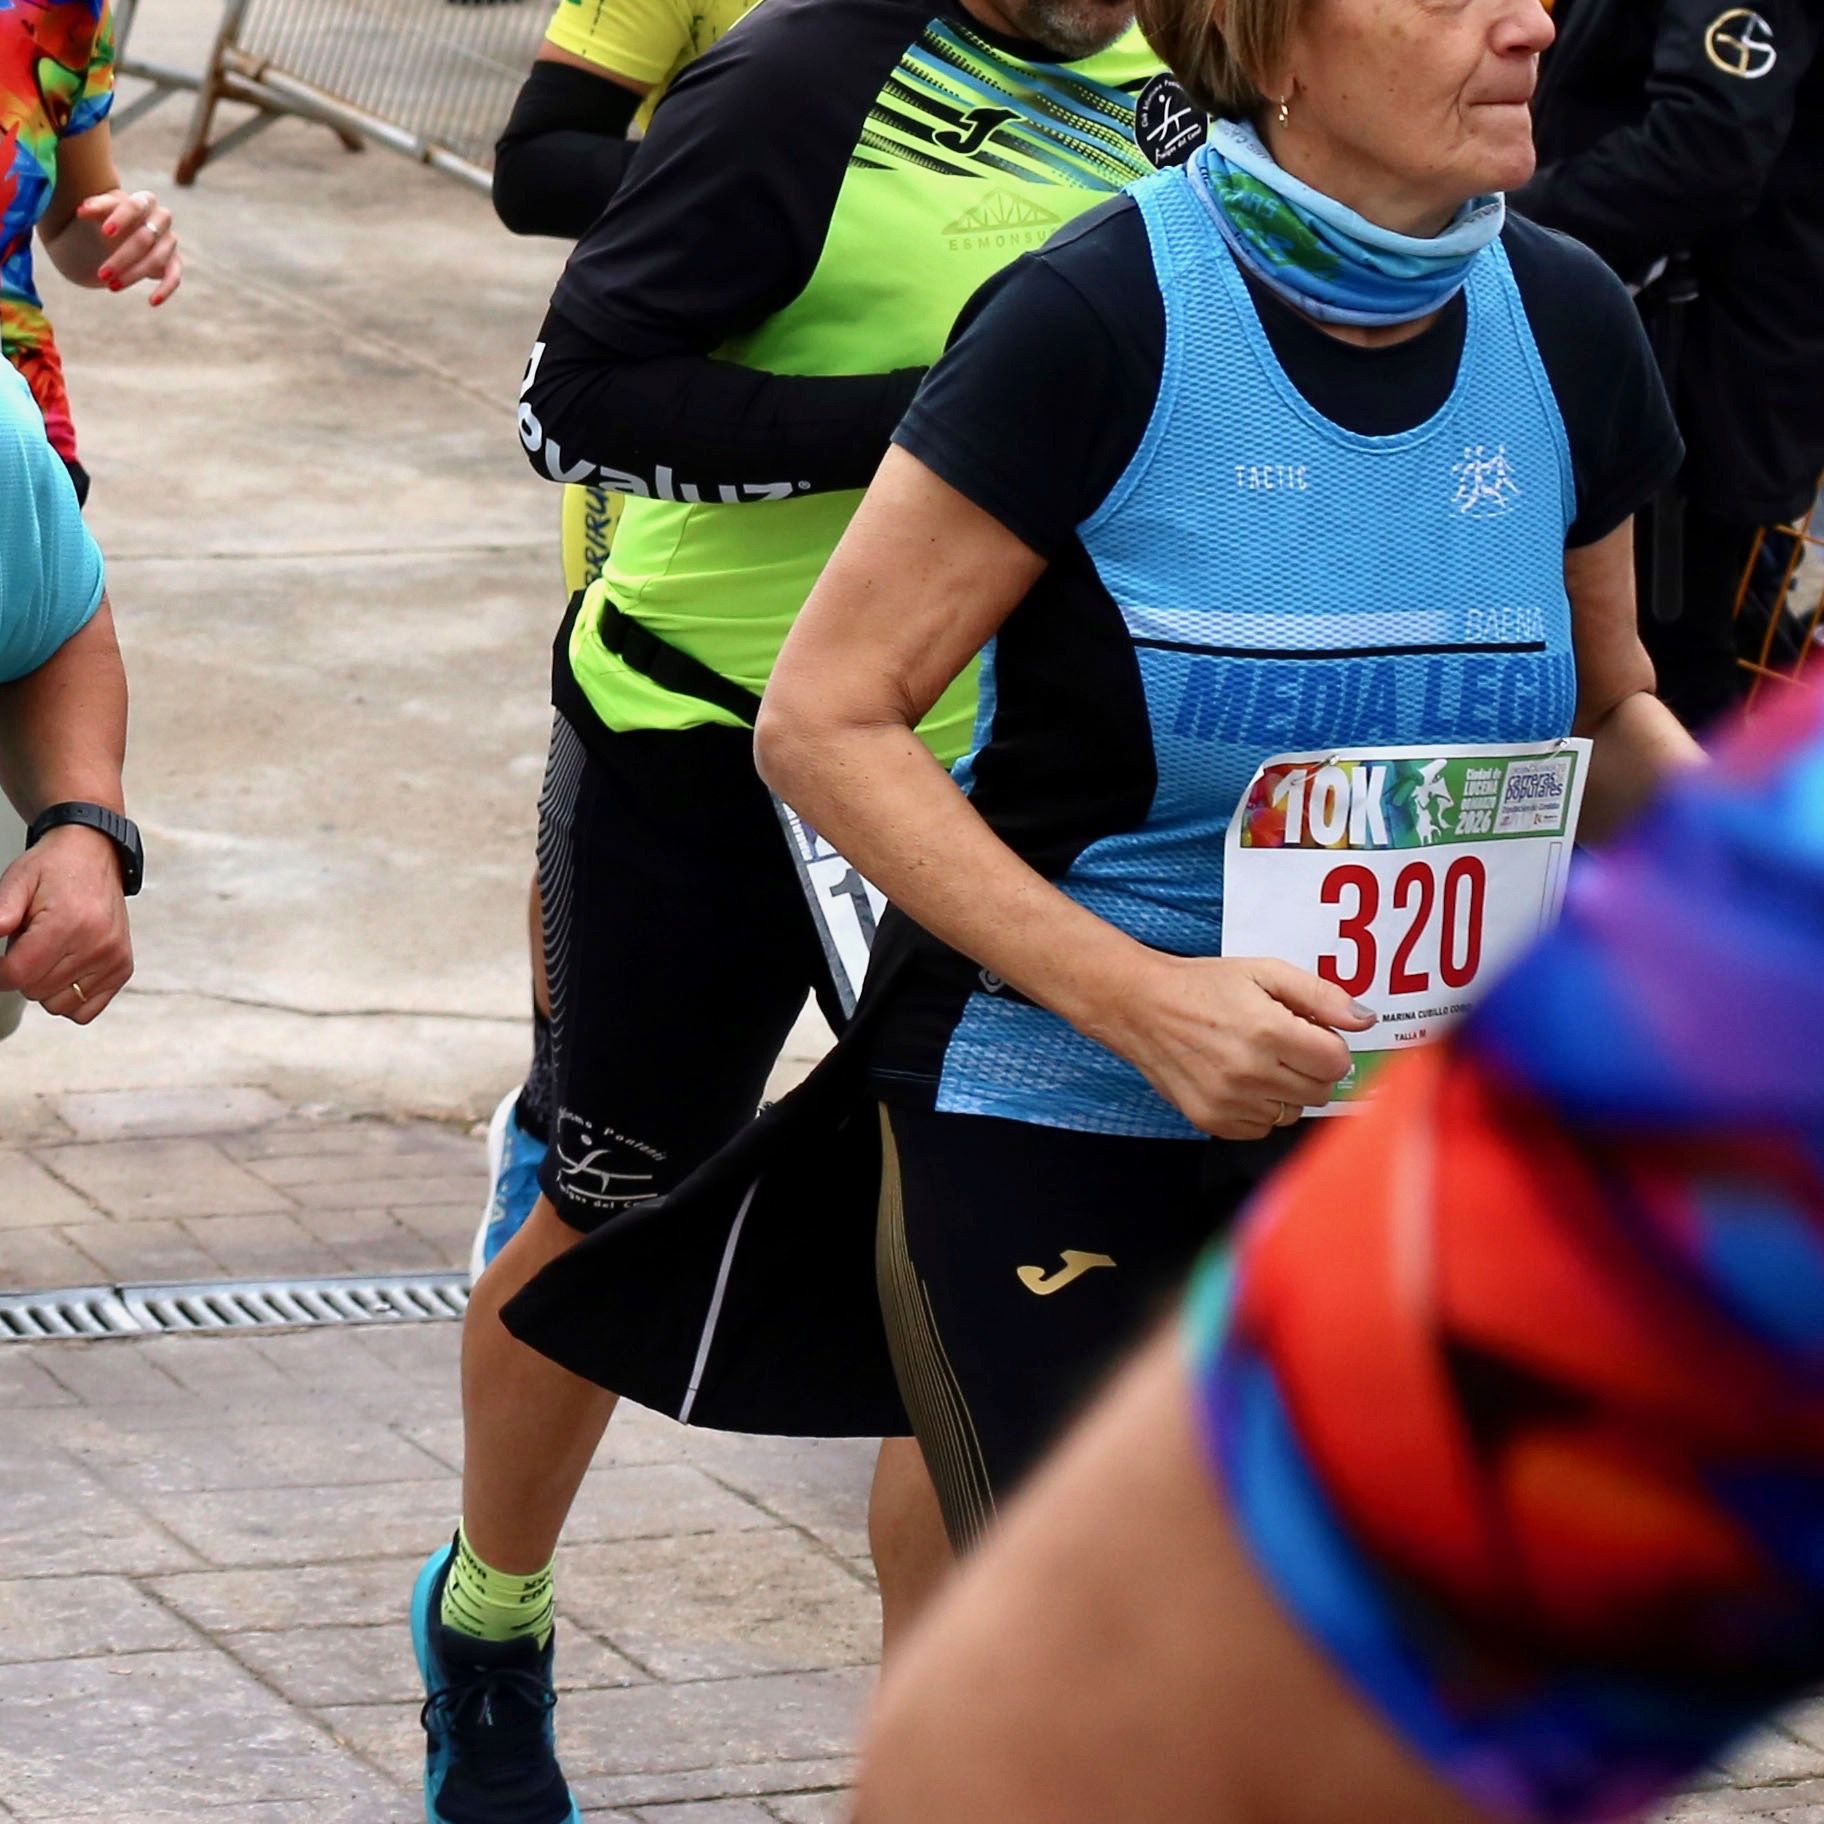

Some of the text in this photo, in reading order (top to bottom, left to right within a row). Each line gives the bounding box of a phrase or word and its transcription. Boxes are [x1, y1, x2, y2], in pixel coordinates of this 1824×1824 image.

[1234, 464, 1310, 491] TACTIC
[1173, 663, 1400, 744] MEDIA
[1508, 772, 1556, 787] carreras
[1505, 783, 1563, 803] populares
[1272, 766, 1389, 846] 10K
[1455, 810, 1492, 835] 2026
[1317, 855, 1487, 999] 320
[1382, 1010, 1417, 1024] MARINA
[1394, 1029, 1418, 1042] TALLA
